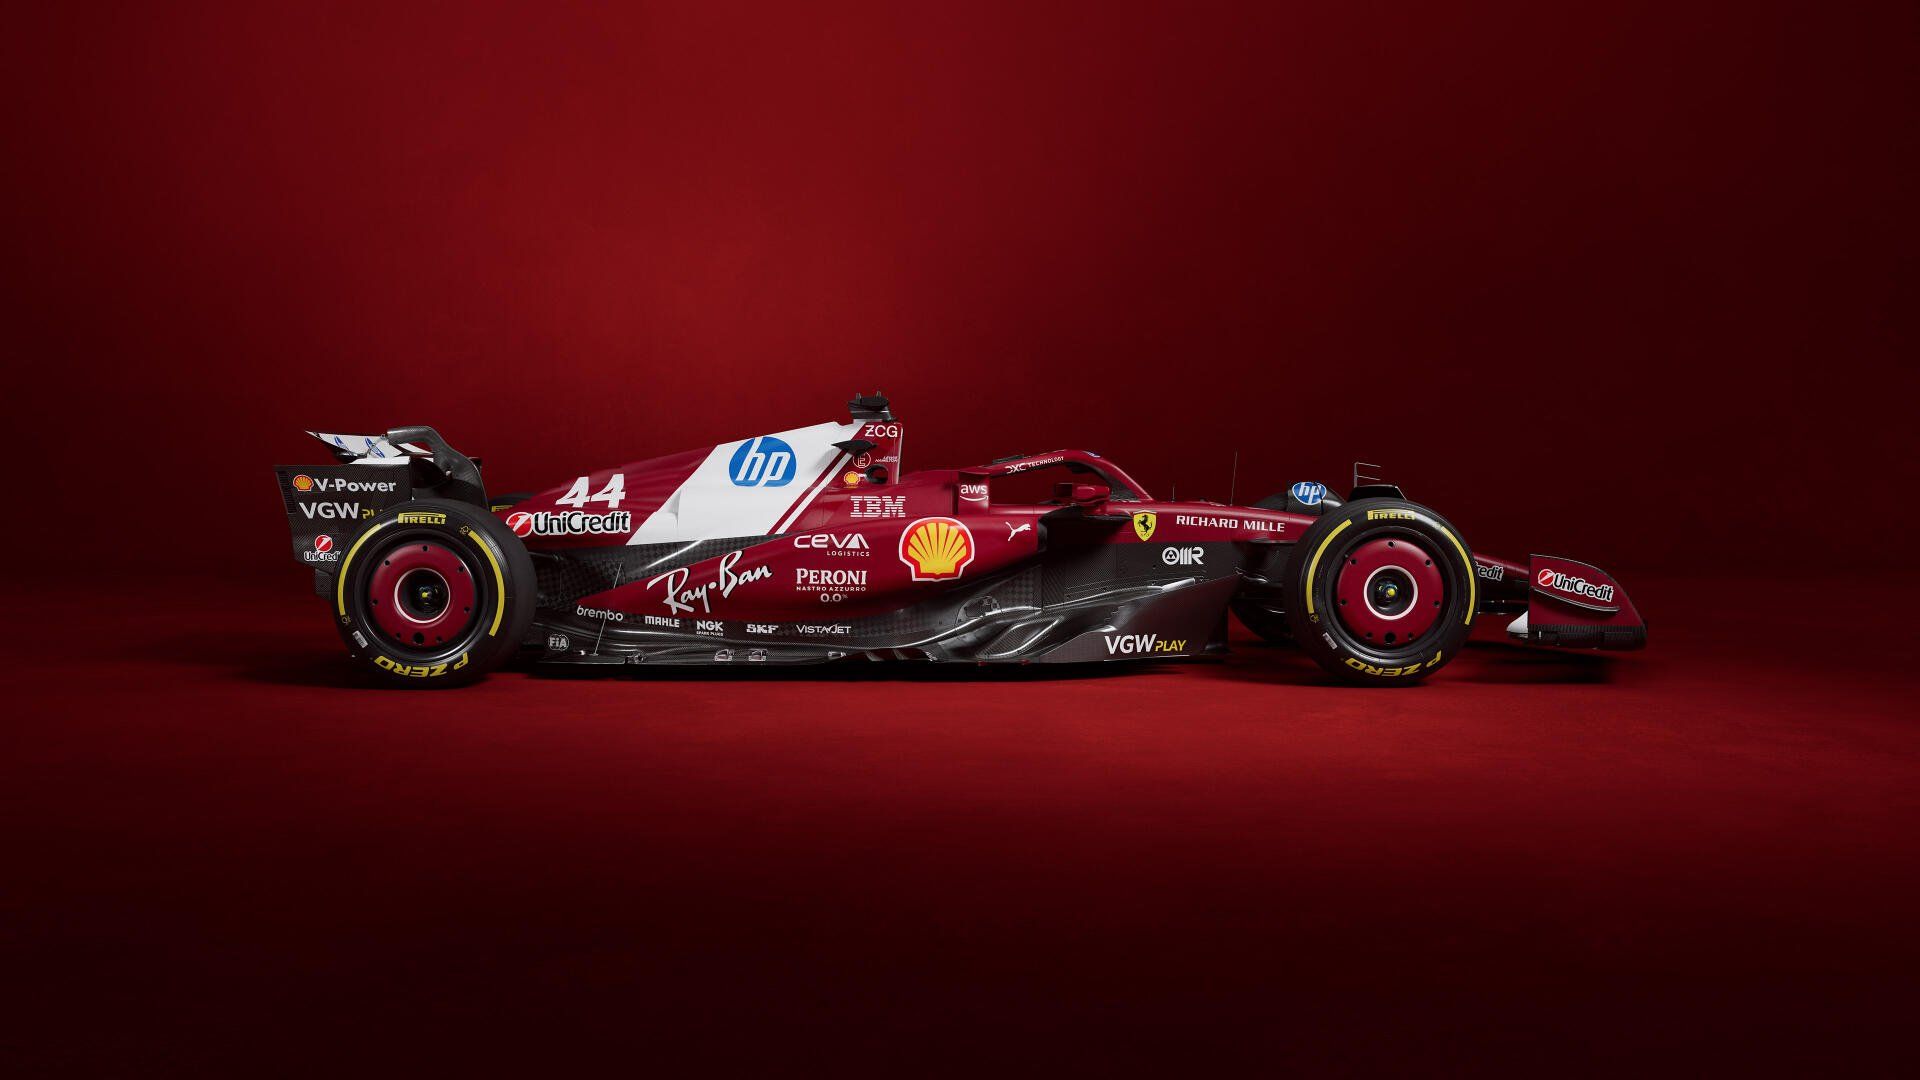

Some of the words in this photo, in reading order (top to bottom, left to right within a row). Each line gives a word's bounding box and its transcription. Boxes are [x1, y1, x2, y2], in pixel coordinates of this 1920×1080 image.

[864, 425, 898, 438] ZCG
[735, 436, 791, 487] hp
[314, 478, 396, 492] V-Power
[555, 474, 626, 508] 44
[960, 484, 988, 494] aws
[1298, 481, 1321, 504] hp
[850, 495, 906, 518] IBM
[1367, 509, 1416, 520] PIRELLI
[397, 512, 447, 525] PIRELLI
[533, 511, 631, 536] UniCredit
[1176, 515, 1239, 529] RICHARD
[1243, 520, 1285, 532] MILLE
[796, 568, 868, 585] PERONI
[1553, 572, 1614, 602] UniCredit
[576, 604, 624, 621] brembo
[644, 615, 681, 628] MAHLE
[696, 620, 724, 632] NGK
[746, 623, 779, 634] SKF
[549, 637, 567, 648] FIA
[373, 655, 448, 678] ZERO
[1344, 657, 1422, 677] ZERO
